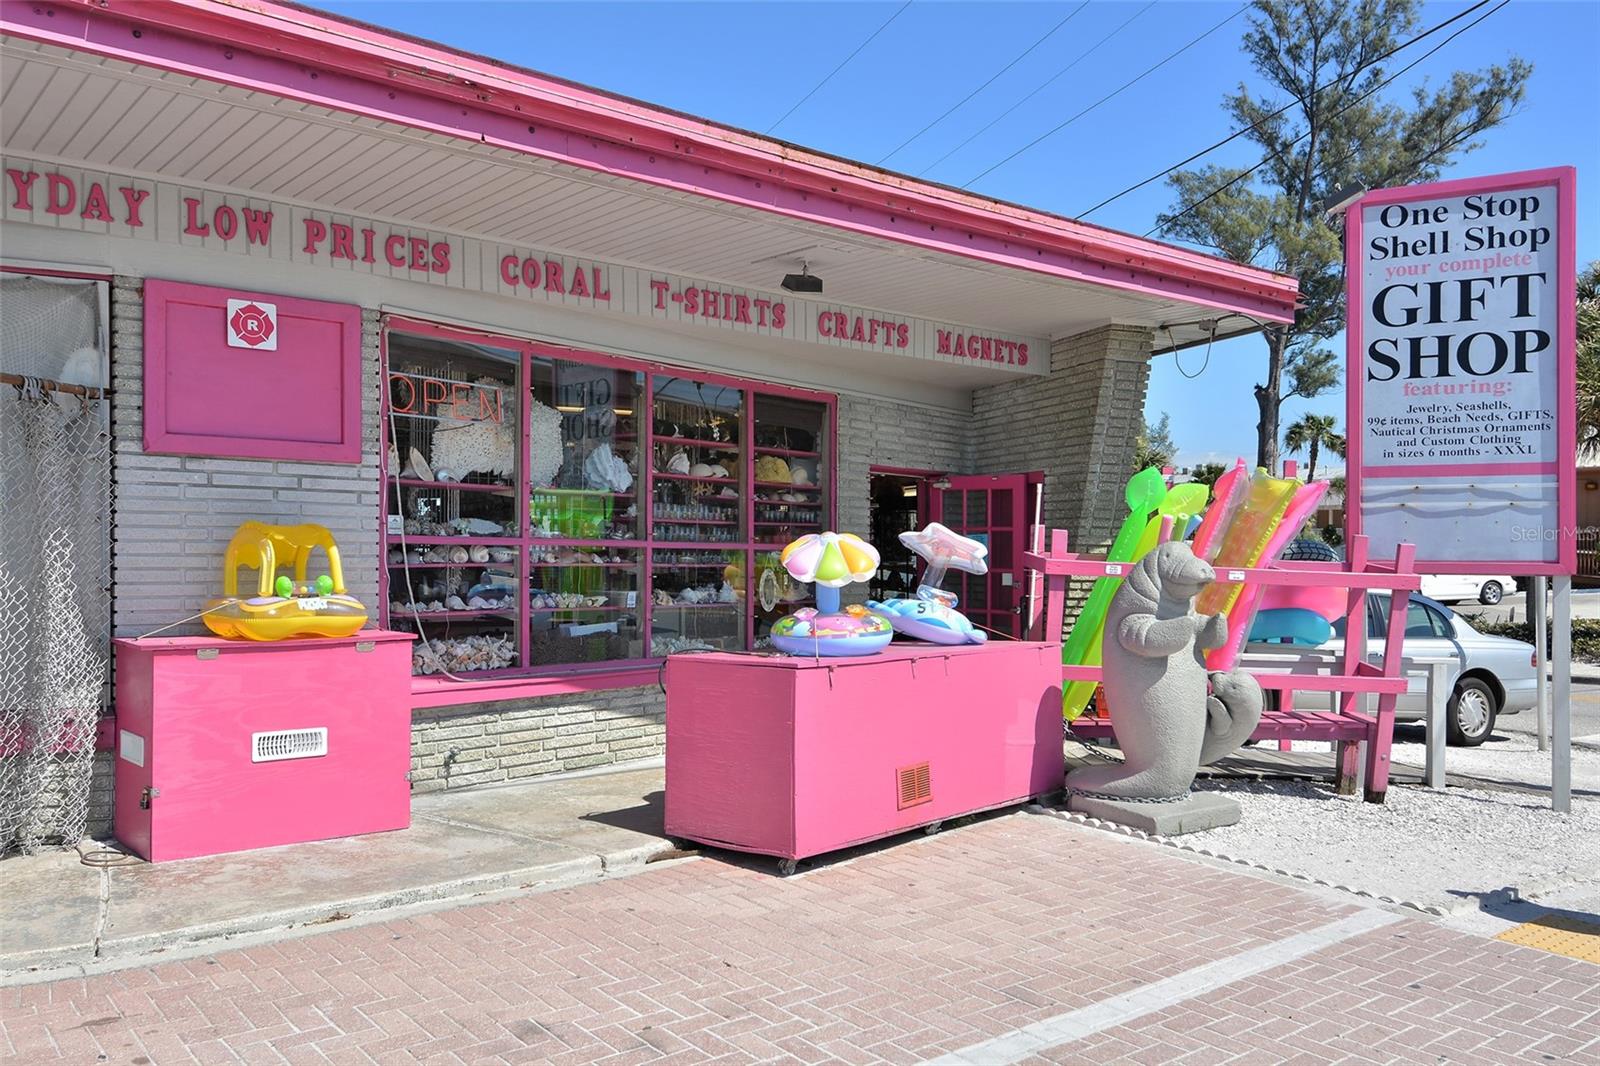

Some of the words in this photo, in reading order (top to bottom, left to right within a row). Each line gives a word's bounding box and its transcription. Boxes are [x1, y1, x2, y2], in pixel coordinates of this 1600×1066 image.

[1380, 204, 1449, 229] One
[1463, 195, 1540, 221] Stop
[1370, 230, 1450, 261] Shell
[1464, 226, 1550, 252] Shop
[5, 168, 151, 227] YDAY
[184, 197, 274, 246] LOW
[303, 219, 451, 274] PRICES
[500, 255, 611, 301] CORAL
[650, 280, 787, 329] T-SHIRTS
[817, 310, 909, 348] CRAFTS
[936, 328, 1029, 366] MAGNETS
[1385, 263, 1431, 281] your
[1439, 252, 1532, 274] complete
[1372, 272, 1547, 328] GIFT
[246, 319, 260, 332] R
[1367, 329, 1551, 382] SHOP
[388, 373, 502, 424] OPEN
[1403, 379, 1512, 397] featuring:
[1390, 416, 1423, 426] items,
[1427, 413, 1461, 424] Beach
[1465, 412, 1504, 423] Needs,
[1507, 408, 1554, 421] GIFTS,
[1406, 403, 1452, 415] Jewelry,
[1455, 400, 1512, 413] Seashells,
[1370, 426, 1416, 437] Nautical
[1419, 425, 1480, 436] Christmas
[1484, 422, 1552, 433] Ornaments
[1396, 437, 1417, 447] and
[1421, 436, 1465, 447] Custom
[1469, 434, 1521, 446] Clothing
[1383, 449, 1394, 459] in
[1398, 448, 1424, 458] sizes
[1428, 448, 1435, 458] 6
[1439, 447, 1481, 457] months
[1493, 445, 1537, 456] XXXL
